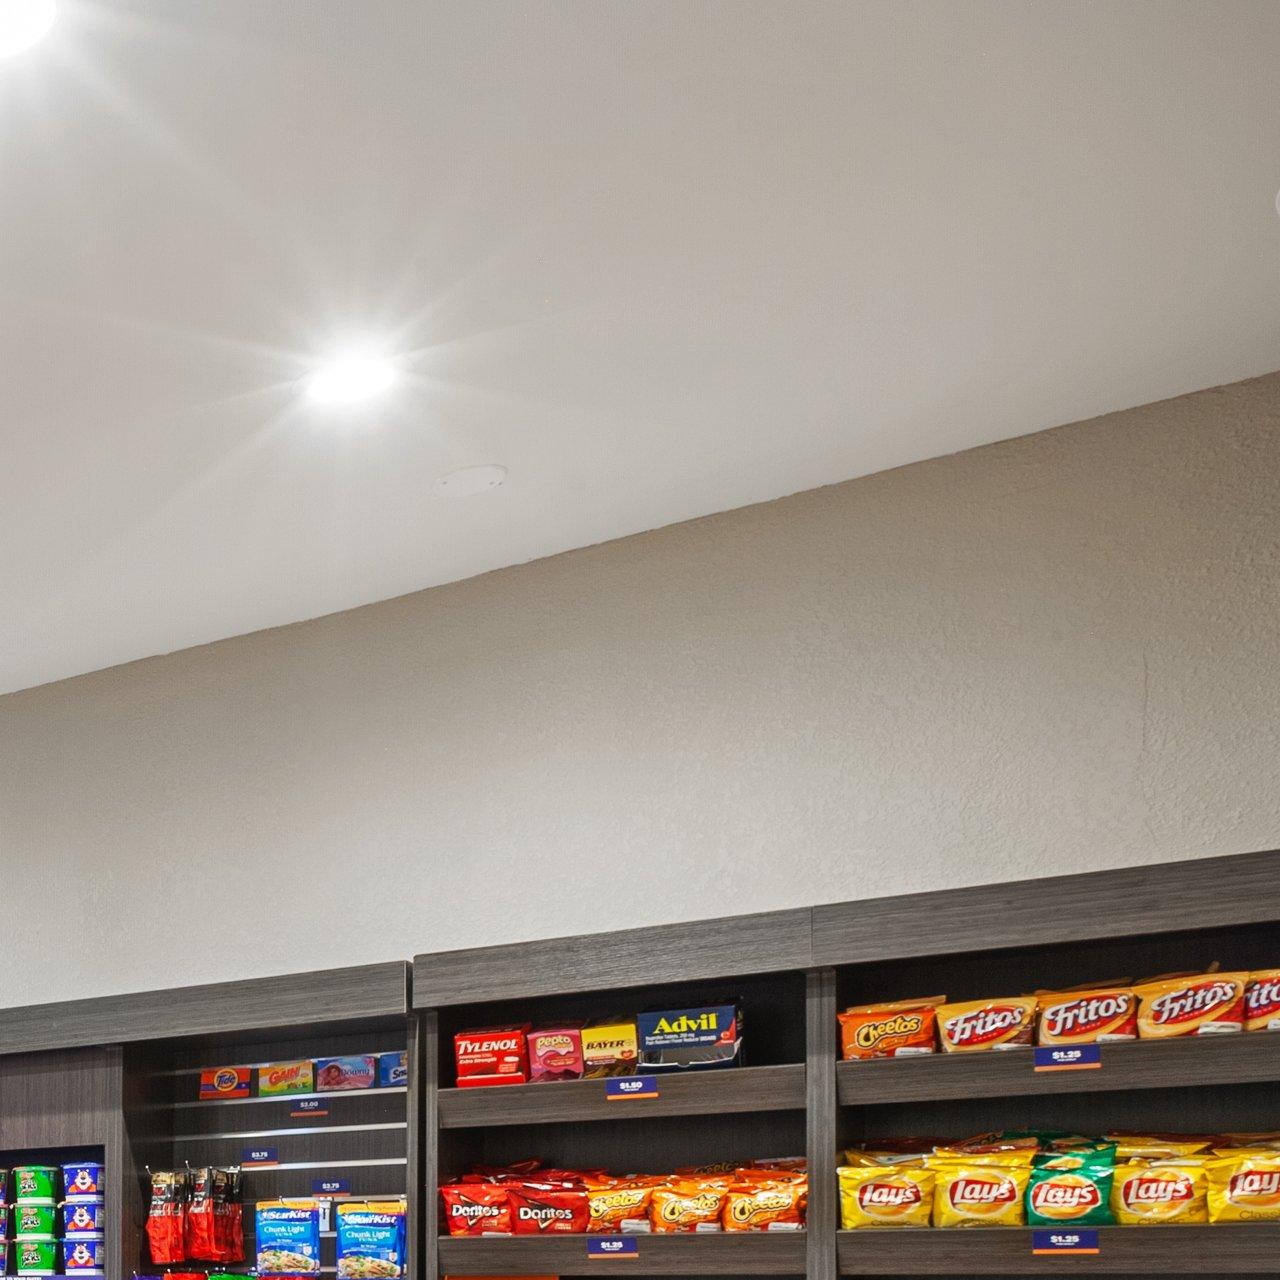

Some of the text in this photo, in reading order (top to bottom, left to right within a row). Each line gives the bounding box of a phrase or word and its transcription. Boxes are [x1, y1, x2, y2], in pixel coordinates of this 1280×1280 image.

[1151, 981, 1238, 1024] Fritos
[653, 1012, 718, 1035] Advil
[944, 1005, 1024, 1046] Fritos
[1044, 993, 1130, 1036] Fritos
[856, 1016, 922, 1048] Cheetos
[457, 1039, 519, 1054] TYLENOL
[586, 1040, 625, 1050] BAYER
[1052, 1050, 1081, 1059] $1.25
[216, 1072, 236, 1088] Tide
[451, 1204, 499, 1217] Doritos
[519, 1207, 573, 1220] Doritos
[590, 1192, 645, 1219] Cheetos
[662, 1195, 720, 1222] Cheetos
[732, 1194, 793, 1222] Cheetos
[1050, 1234, 1080, 1244] $1.25
